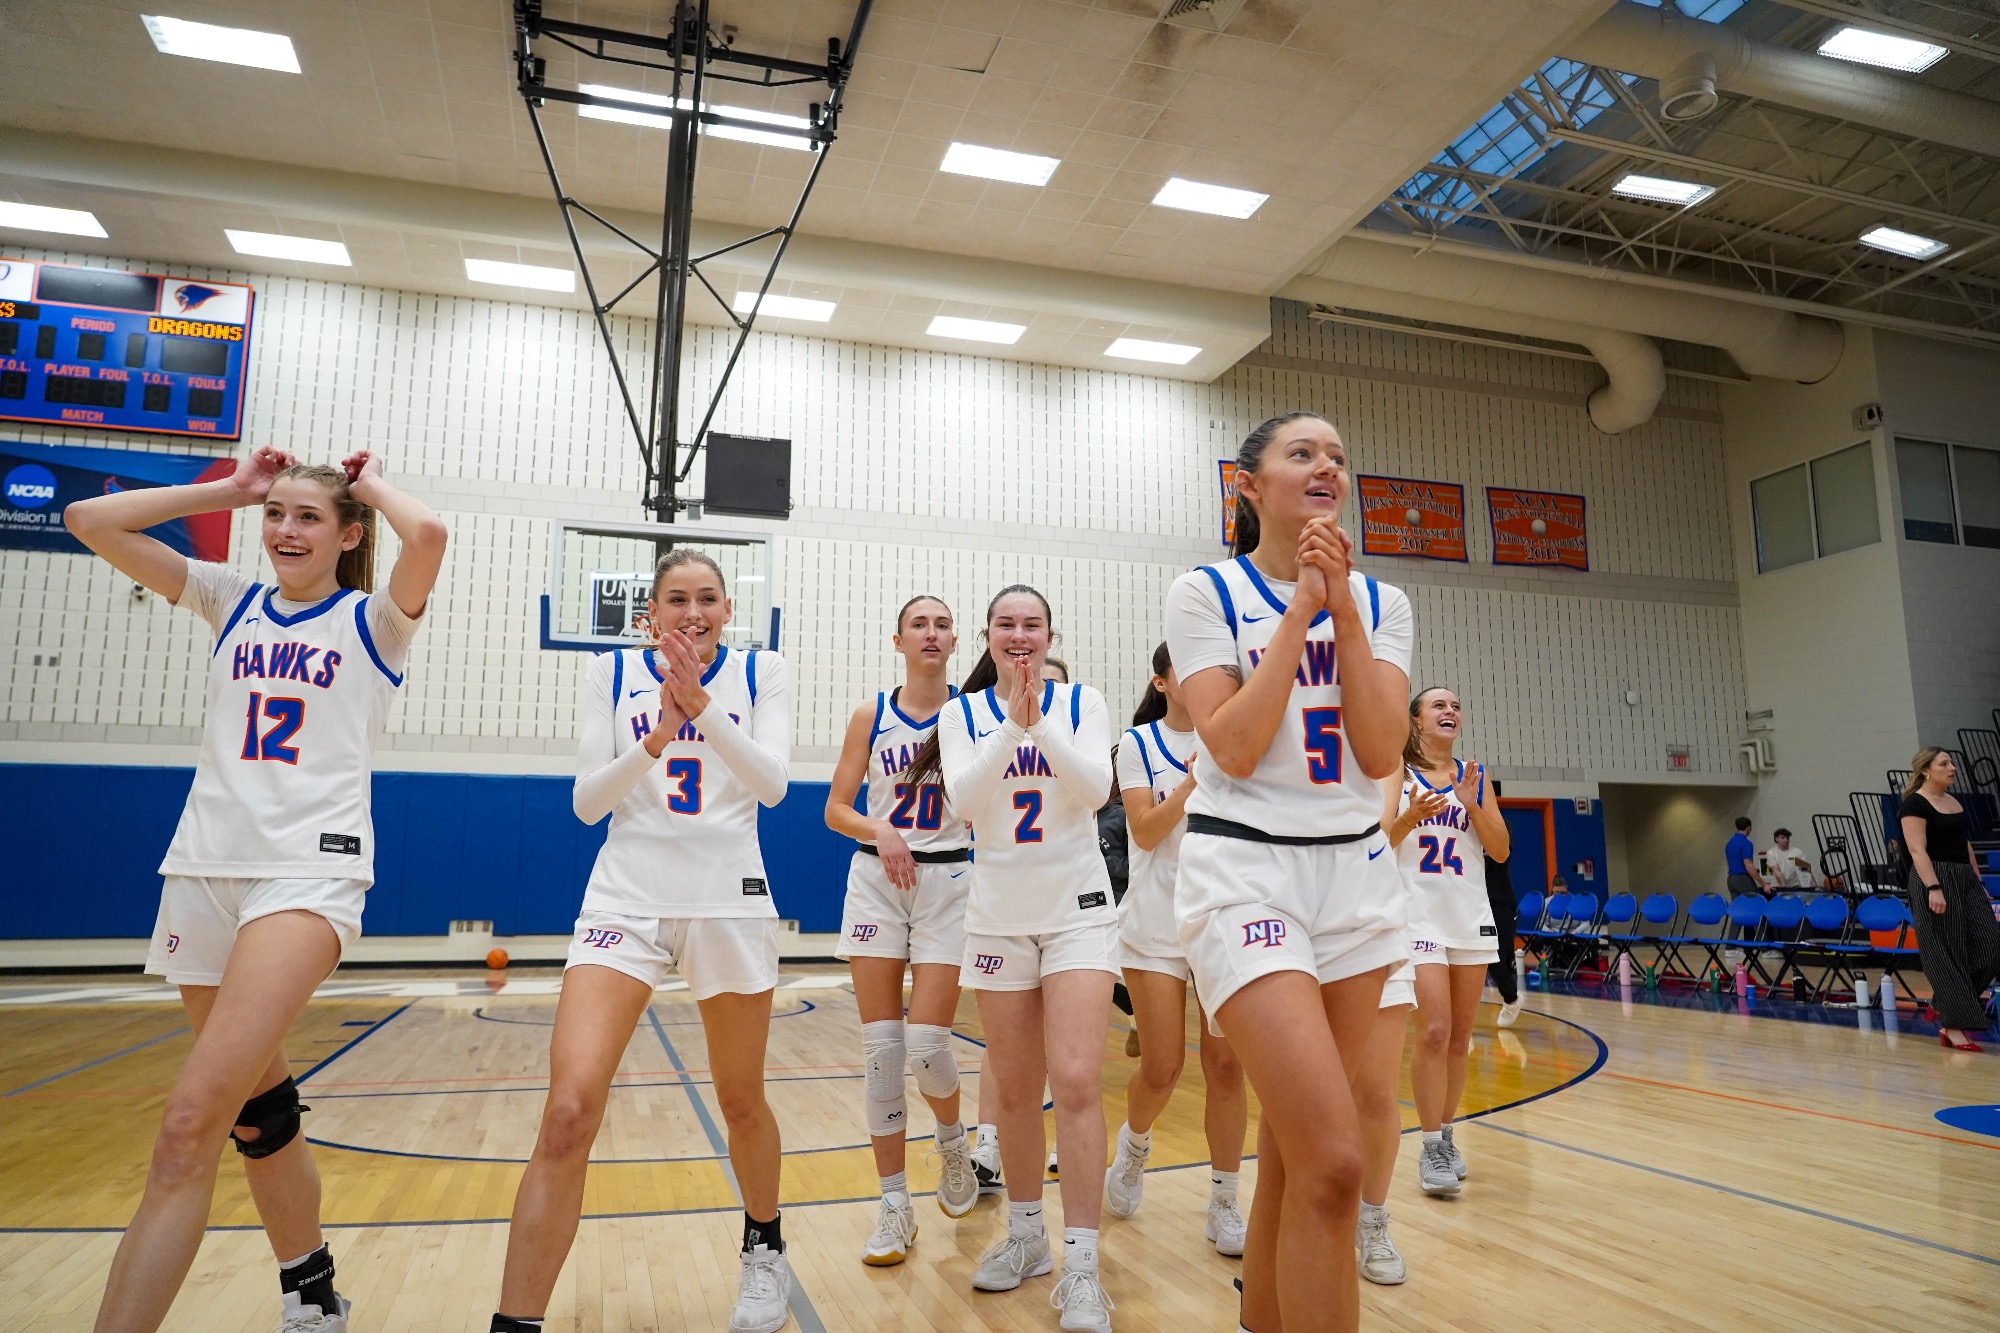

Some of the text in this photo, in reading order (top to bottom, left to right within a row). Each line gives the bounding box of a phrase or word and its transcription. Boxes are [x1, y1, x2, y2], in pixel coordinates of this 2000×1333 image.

[71, 317, 116, 332] PERIOD
[148, 317, 242, 341] DRAGONS
[44, 364, 130, 382] PLAYER FOUL
[143, 372, 175, 386] T.O.L.
[187, 377, 226, 390] FOULS
[61, 408, 104, 423] MATCH
[188, 420, 216, 432] WON
[7, 484, 55, 499] NCAA
[1387, 481, 1435, 500] NCAA
[1396, 498, 1461, 520] VOLLEYBALL
[1514, 493, 1559, 510] NCAA
[1365, 519, 1462, 541] NATIONAL RUNNER UP
[1398, 536, 1431, 553] 2017
[601, 598, 640, 607] VOLLEYLL
[233, 640, 341, 689] HAWKS
[240, 691, 305, 766] 12
[1302, 706, 1342, 785] 5
[1672, 756, 1687, 768] EXIT
[667, 757, 702, 816] 3
[889, 782, 943, 831] 20
[1013, 789, 1043, 844] 2
[1418, 835, 1464, 877] 24
[583, 929, 623, 948] NP
[852, 924, 878, 942] NP
[1241, 919, 1286, 949] NP
[974, 953, 1004, 975] NP
